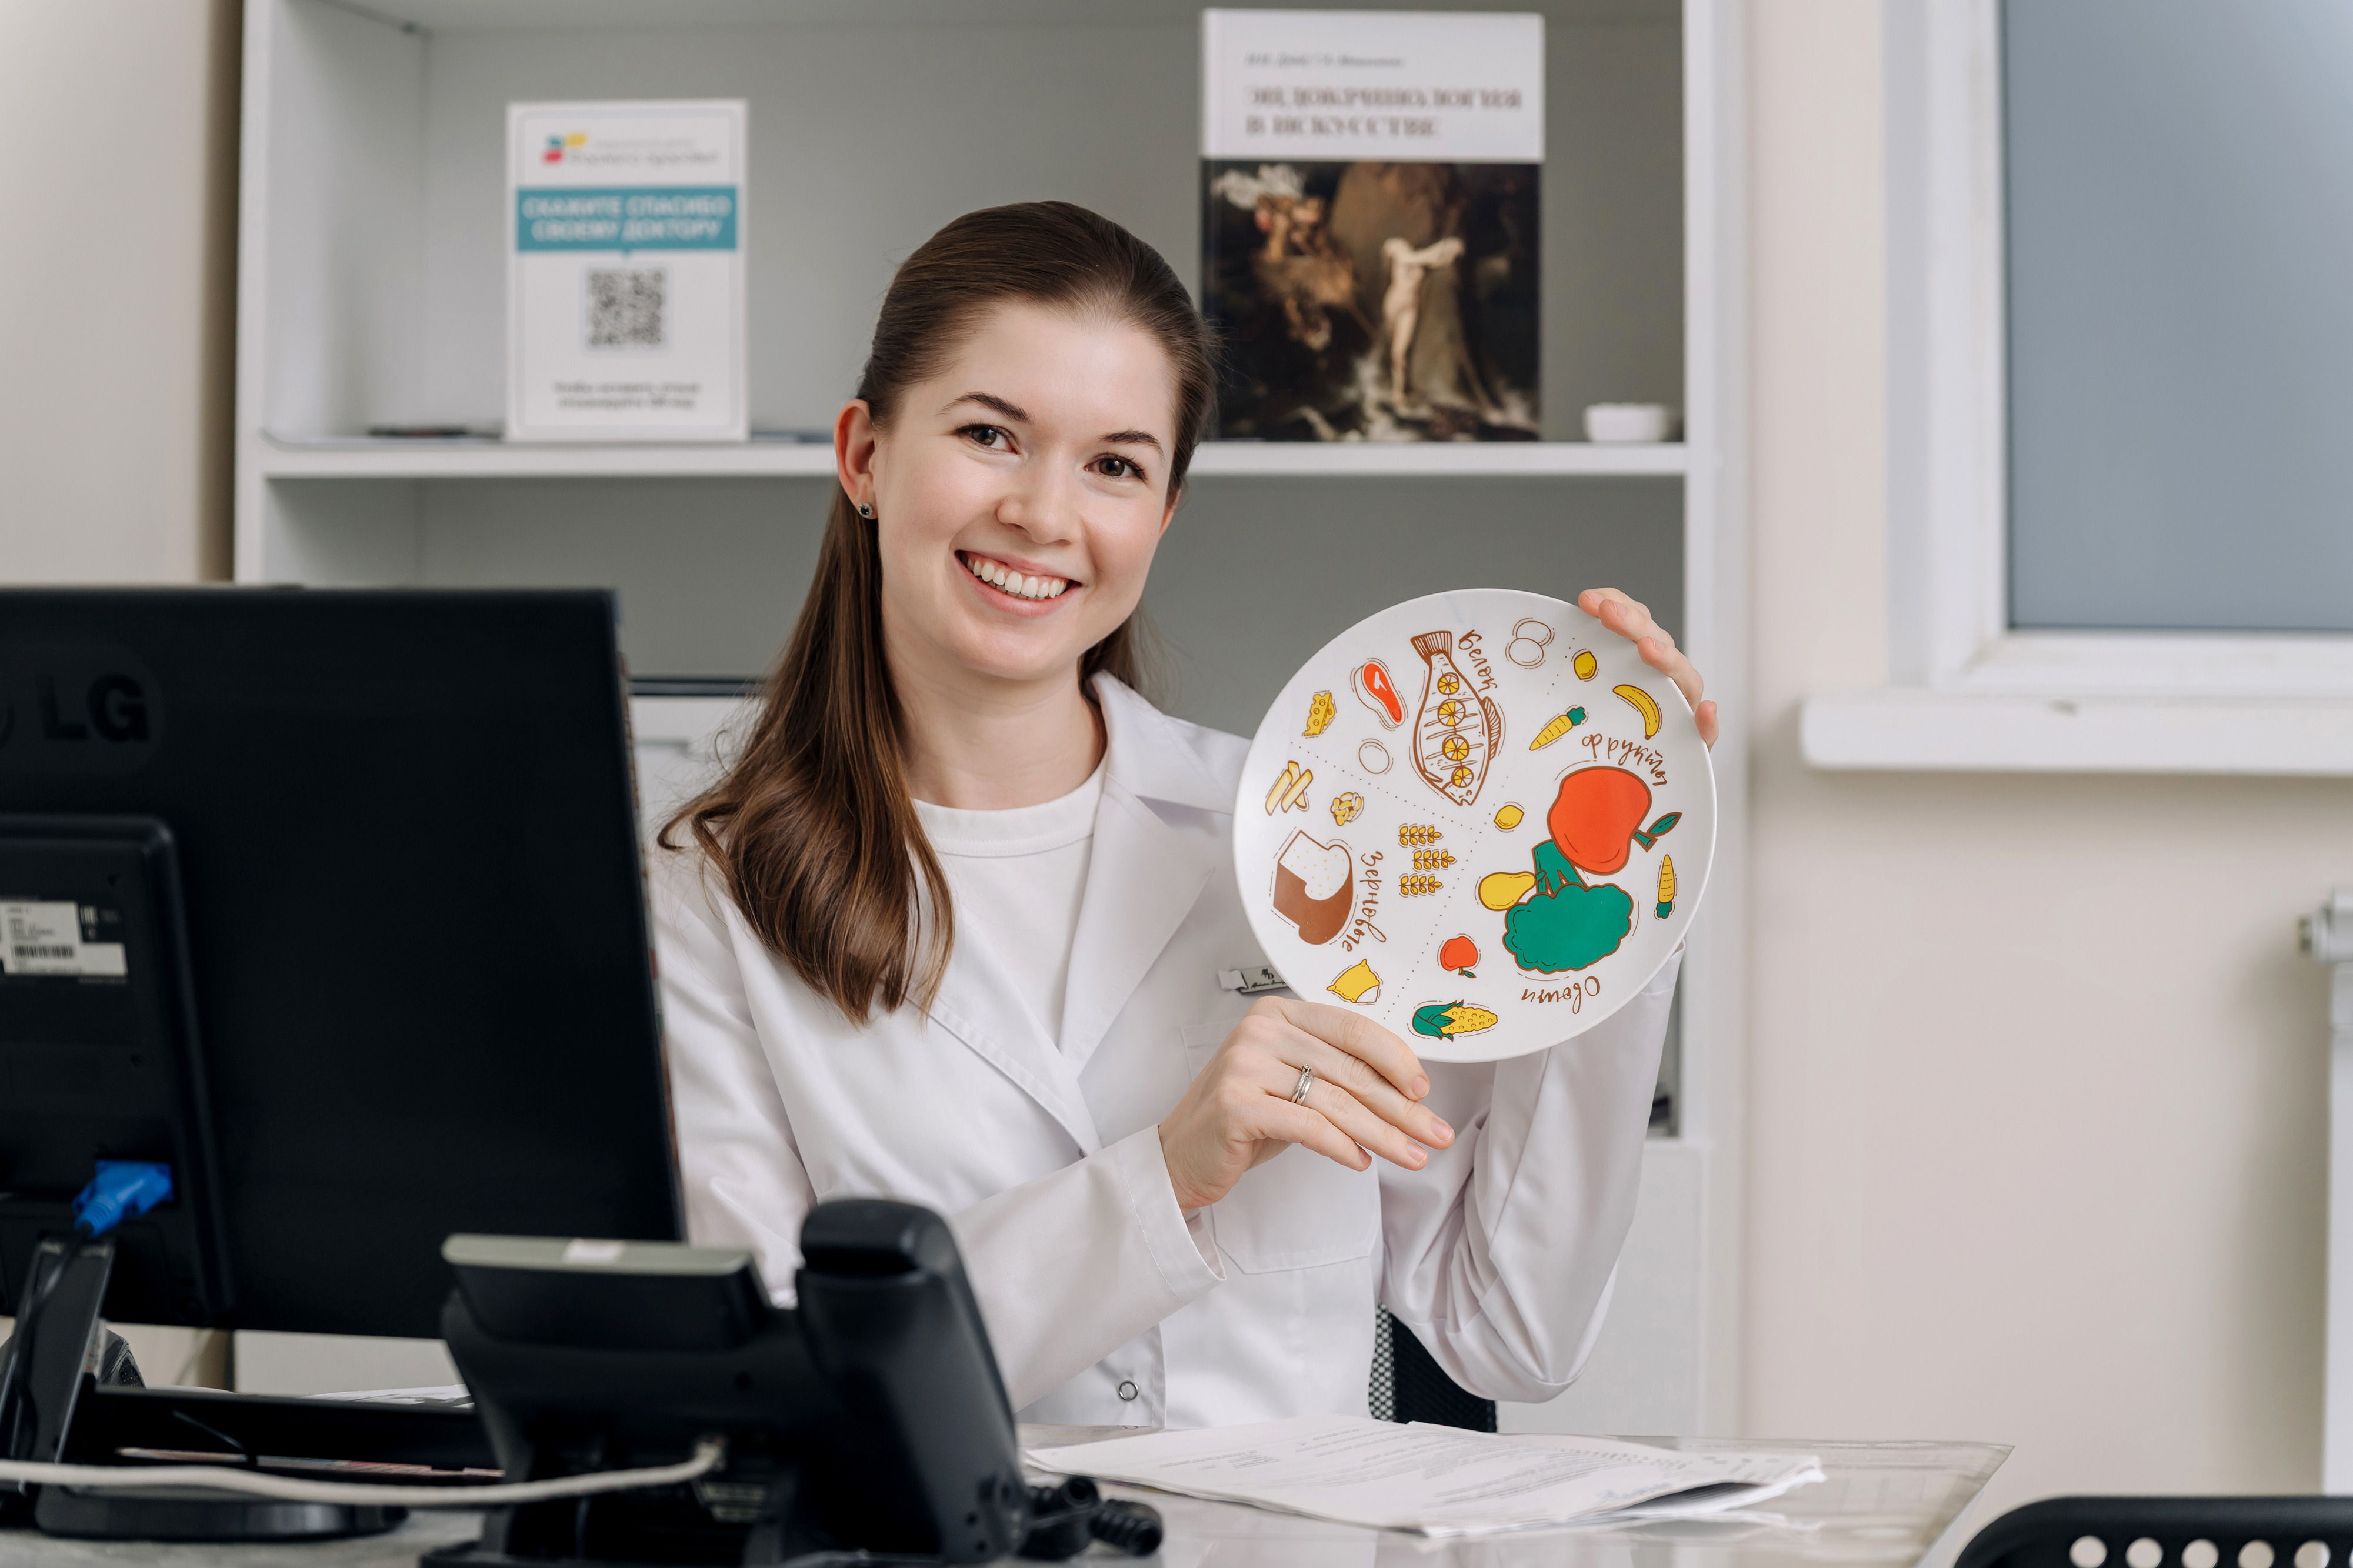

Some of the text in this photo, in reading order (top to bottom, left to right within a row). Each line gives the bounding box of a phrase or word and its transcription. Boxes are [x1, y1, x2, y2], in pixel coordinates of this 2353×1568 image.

[1273, 116, 1437, 138] ИСКУССТВЕ
[522, 195, 731, 219] СКАЖИТЕ СПАСИБО
[531, 218, 723, 242] СВОЕМУ ДОКТОРУ
[1458, 629, 1497, 693] Белок
[35, 674, 149, 742] LG
[1581, 733, 1667, 786] Фрукты
[1342, 851, 1387, 952] Зерновые
[1521, 976, 1600, 1014] Овощи
